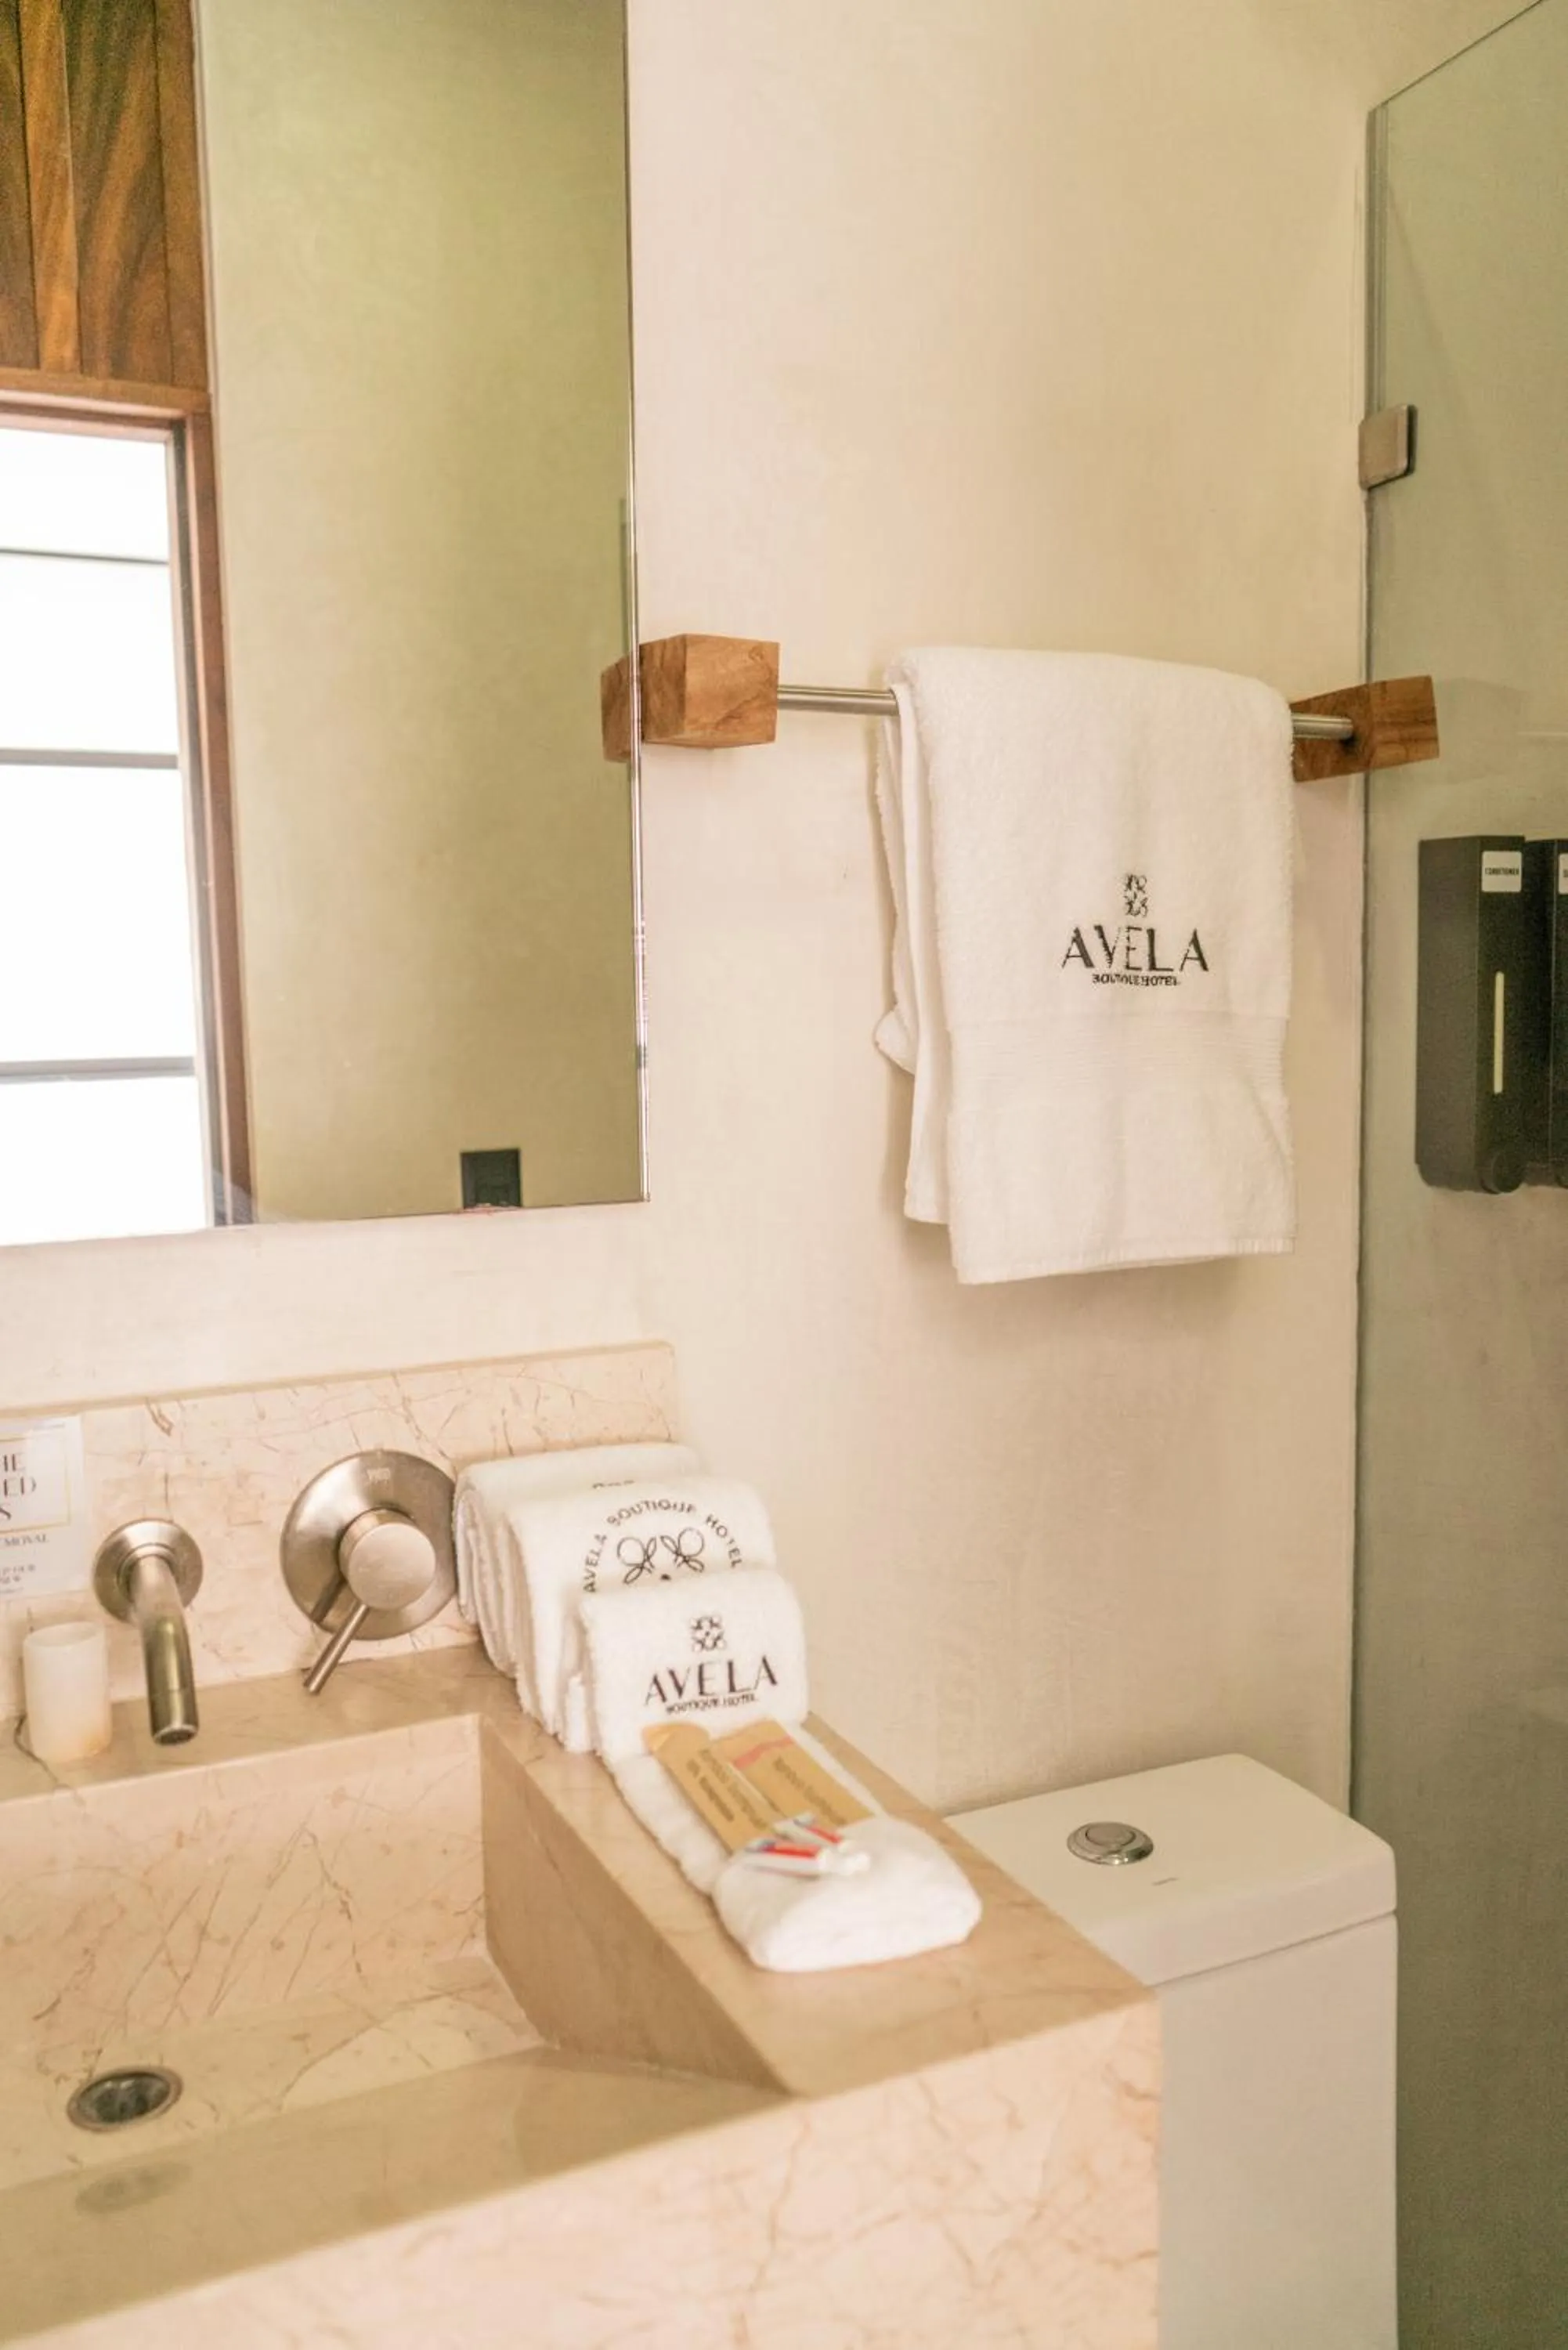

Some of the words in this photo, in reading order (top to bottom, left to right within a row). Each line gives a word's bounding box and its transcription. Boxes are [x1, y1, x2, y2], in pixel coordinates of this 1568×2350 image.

[1060, 924, 1210, 973] AVELA
[582, 1532, 608, 1593] AVELA
[704, 1513, 743, 1569] HOTEL
[643, 1654, 779, 1707] AVELA
